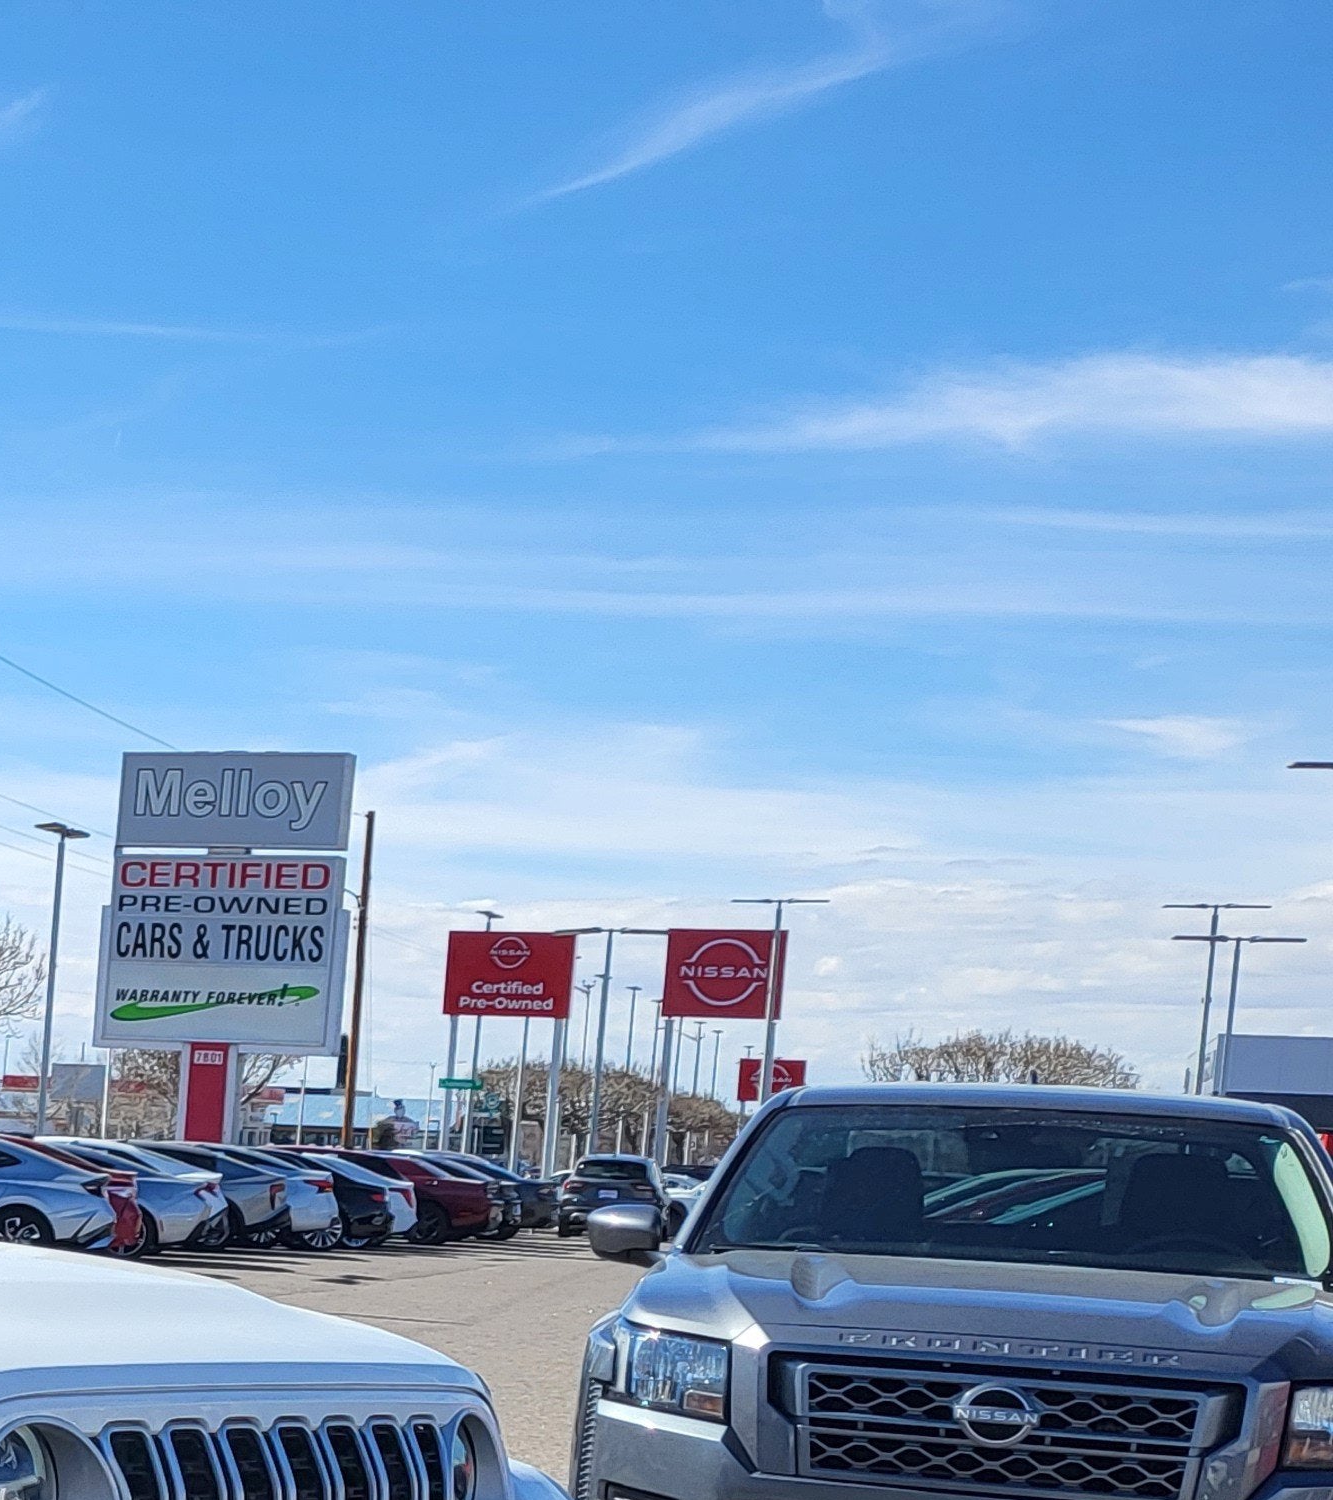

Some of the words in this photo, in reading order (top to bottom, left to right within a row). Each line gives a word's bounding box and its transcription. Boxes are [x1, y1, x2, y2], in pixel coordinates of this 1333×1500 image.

[134, 768, 328, 831] Melloy
[120, 861, 330, 890] CERTIFIED
[117, 895, 328, 916] PRE-OWNED
[116, 921, 183, 959] CARS
[193, 923, 210, 960] &
[221, 924, 324, 963] TRUCKS
[678, 964, 768, 979] NISSAN
[115, 987, 201, 1004] WARRANTY
[206, 984, 290, 1007] FOREVER!
[470, 981, 544, 996] Certified
[457, 995, 554, 1011] Pre-Owned
[196, 1051, 222, 1064] 7801
[955, 1407, 1038, 1424] NISSAN
